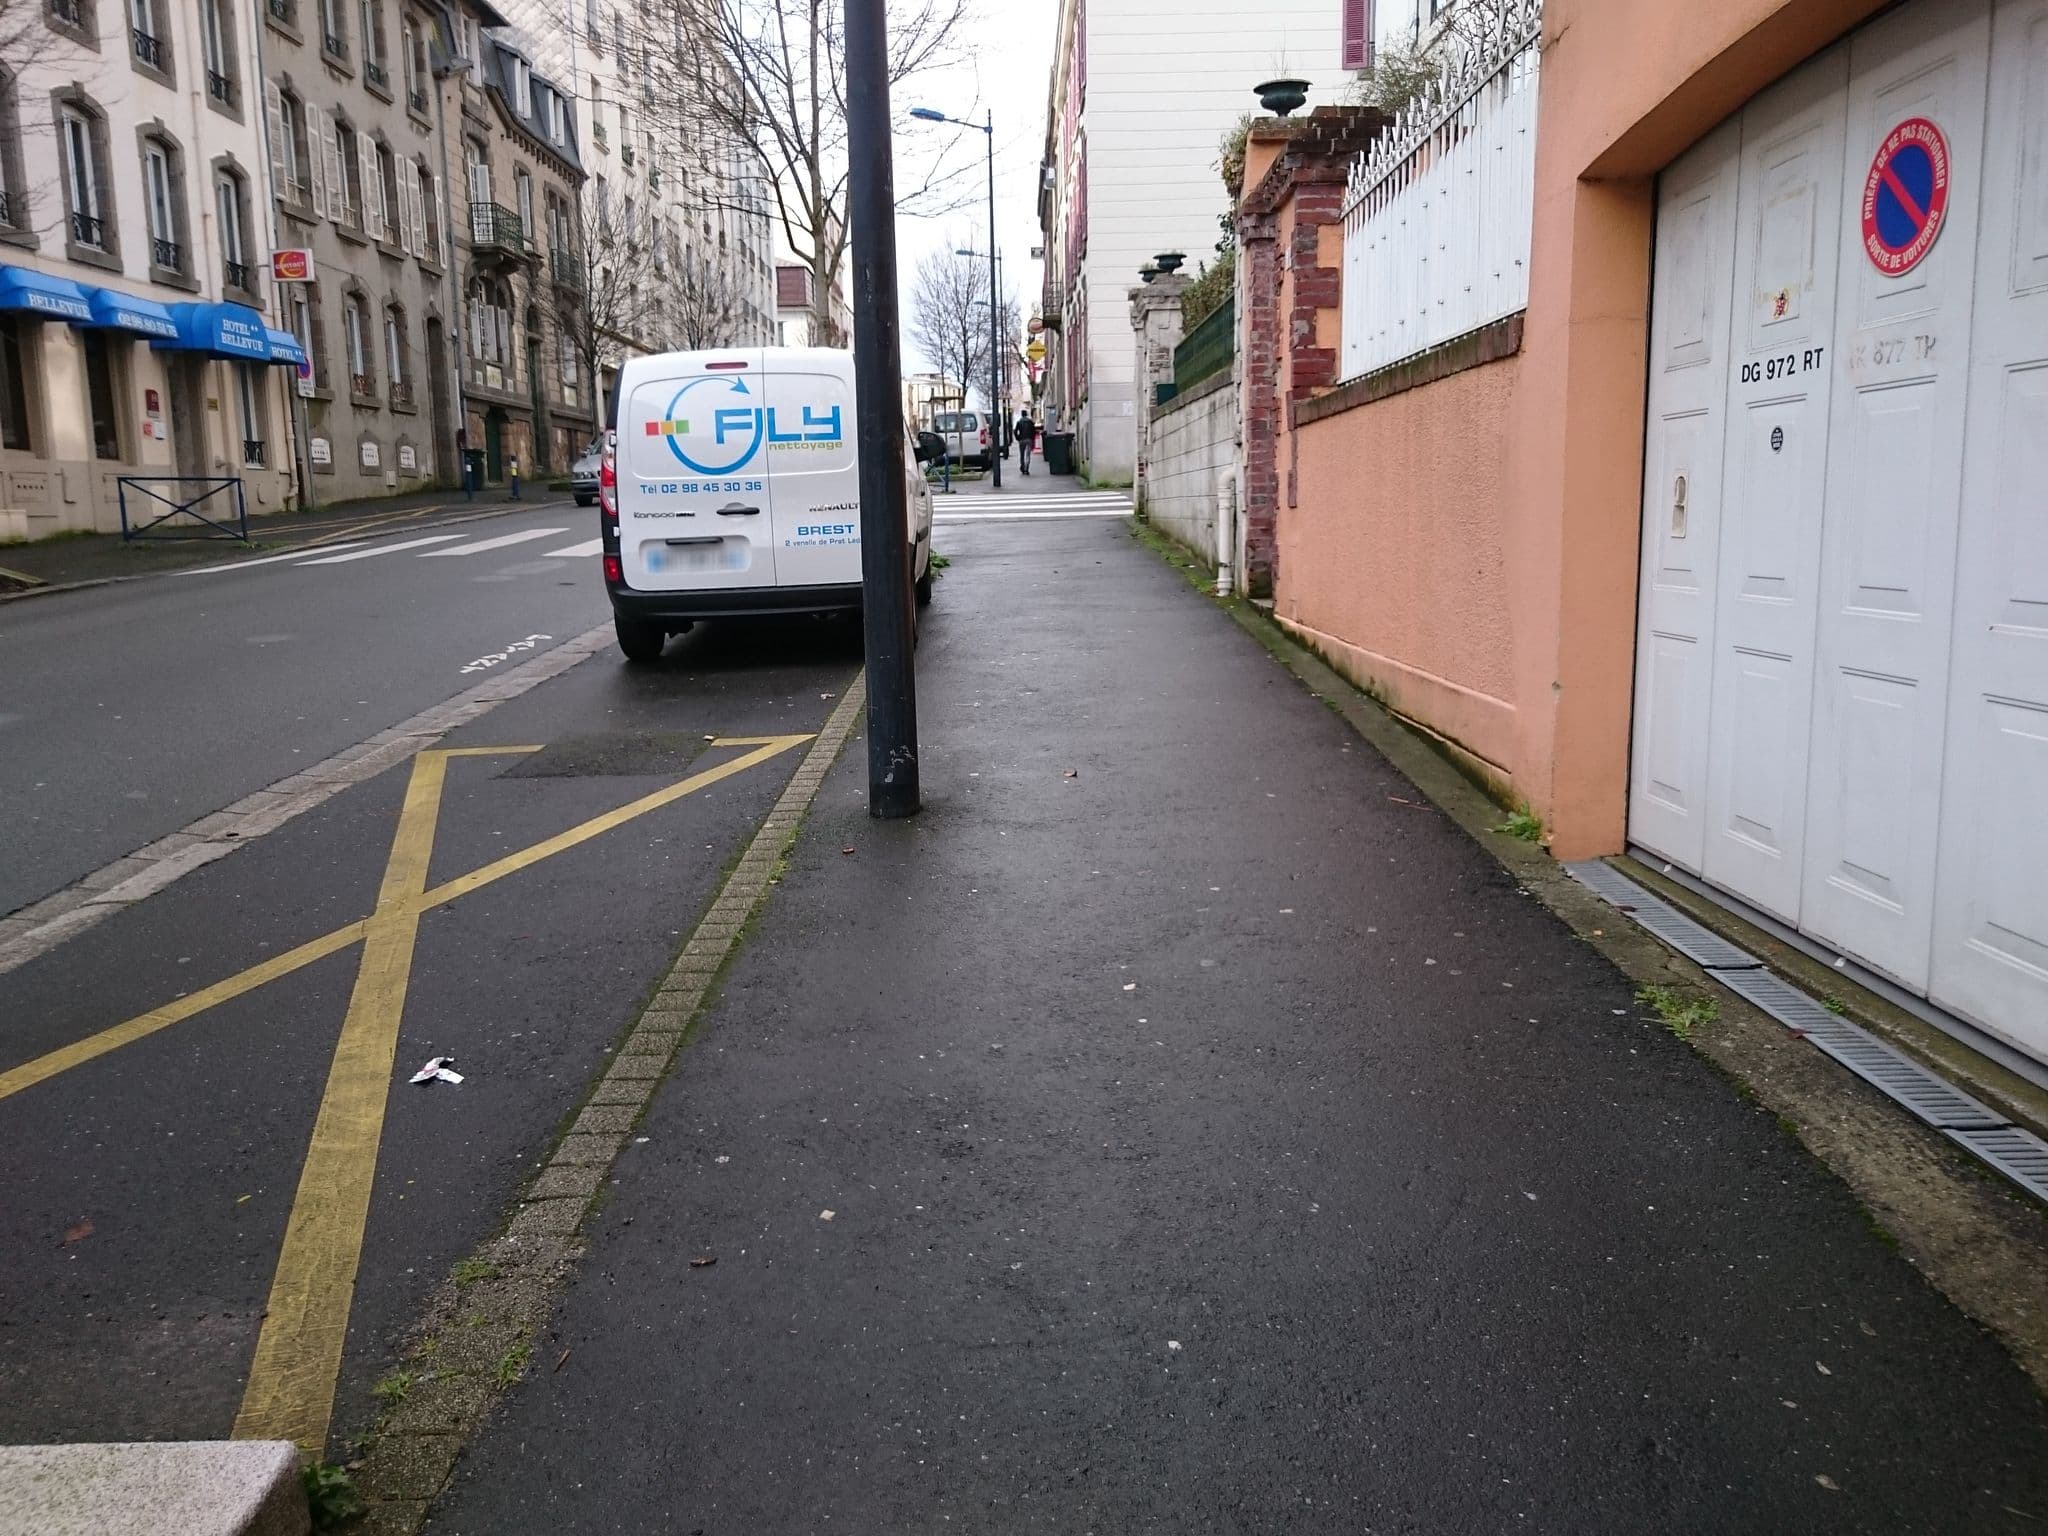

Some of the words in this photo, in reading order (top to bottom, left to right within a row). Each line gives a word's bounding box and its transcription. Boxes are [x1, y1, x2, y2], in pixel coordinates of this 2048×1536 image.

[1876, 148, 1889, 169] DE
[1887, 133, 1900, 152] NE
[1900, 124, 1917, 142] PAS
[1916, 125, 1945, 190] STATIONNER
[1867, 233, 1890, 267] SORTIE
[1889, 254, 1901, 268] DE
[1902, 209, 1939, 264] VOITURES
[28, 293, 93, 321] BELLEVUE
[221, 332, 264, 352] BELLEVUE
[1741, 362, 1761, 383] DG
[1766, 354, 1796, 380] 972
[1803, 347, 1824, 371] RT
[768, 441, 843, 452] nettoyage
[661, 484, 678, 494] 02
[682, 483, 698, 493] 98
[703, 482, 720, 492] 45
[724, 482, 741, 492] 30
[745, 481, 762, 491] 36
[797, 524, 855, 536] BREST
